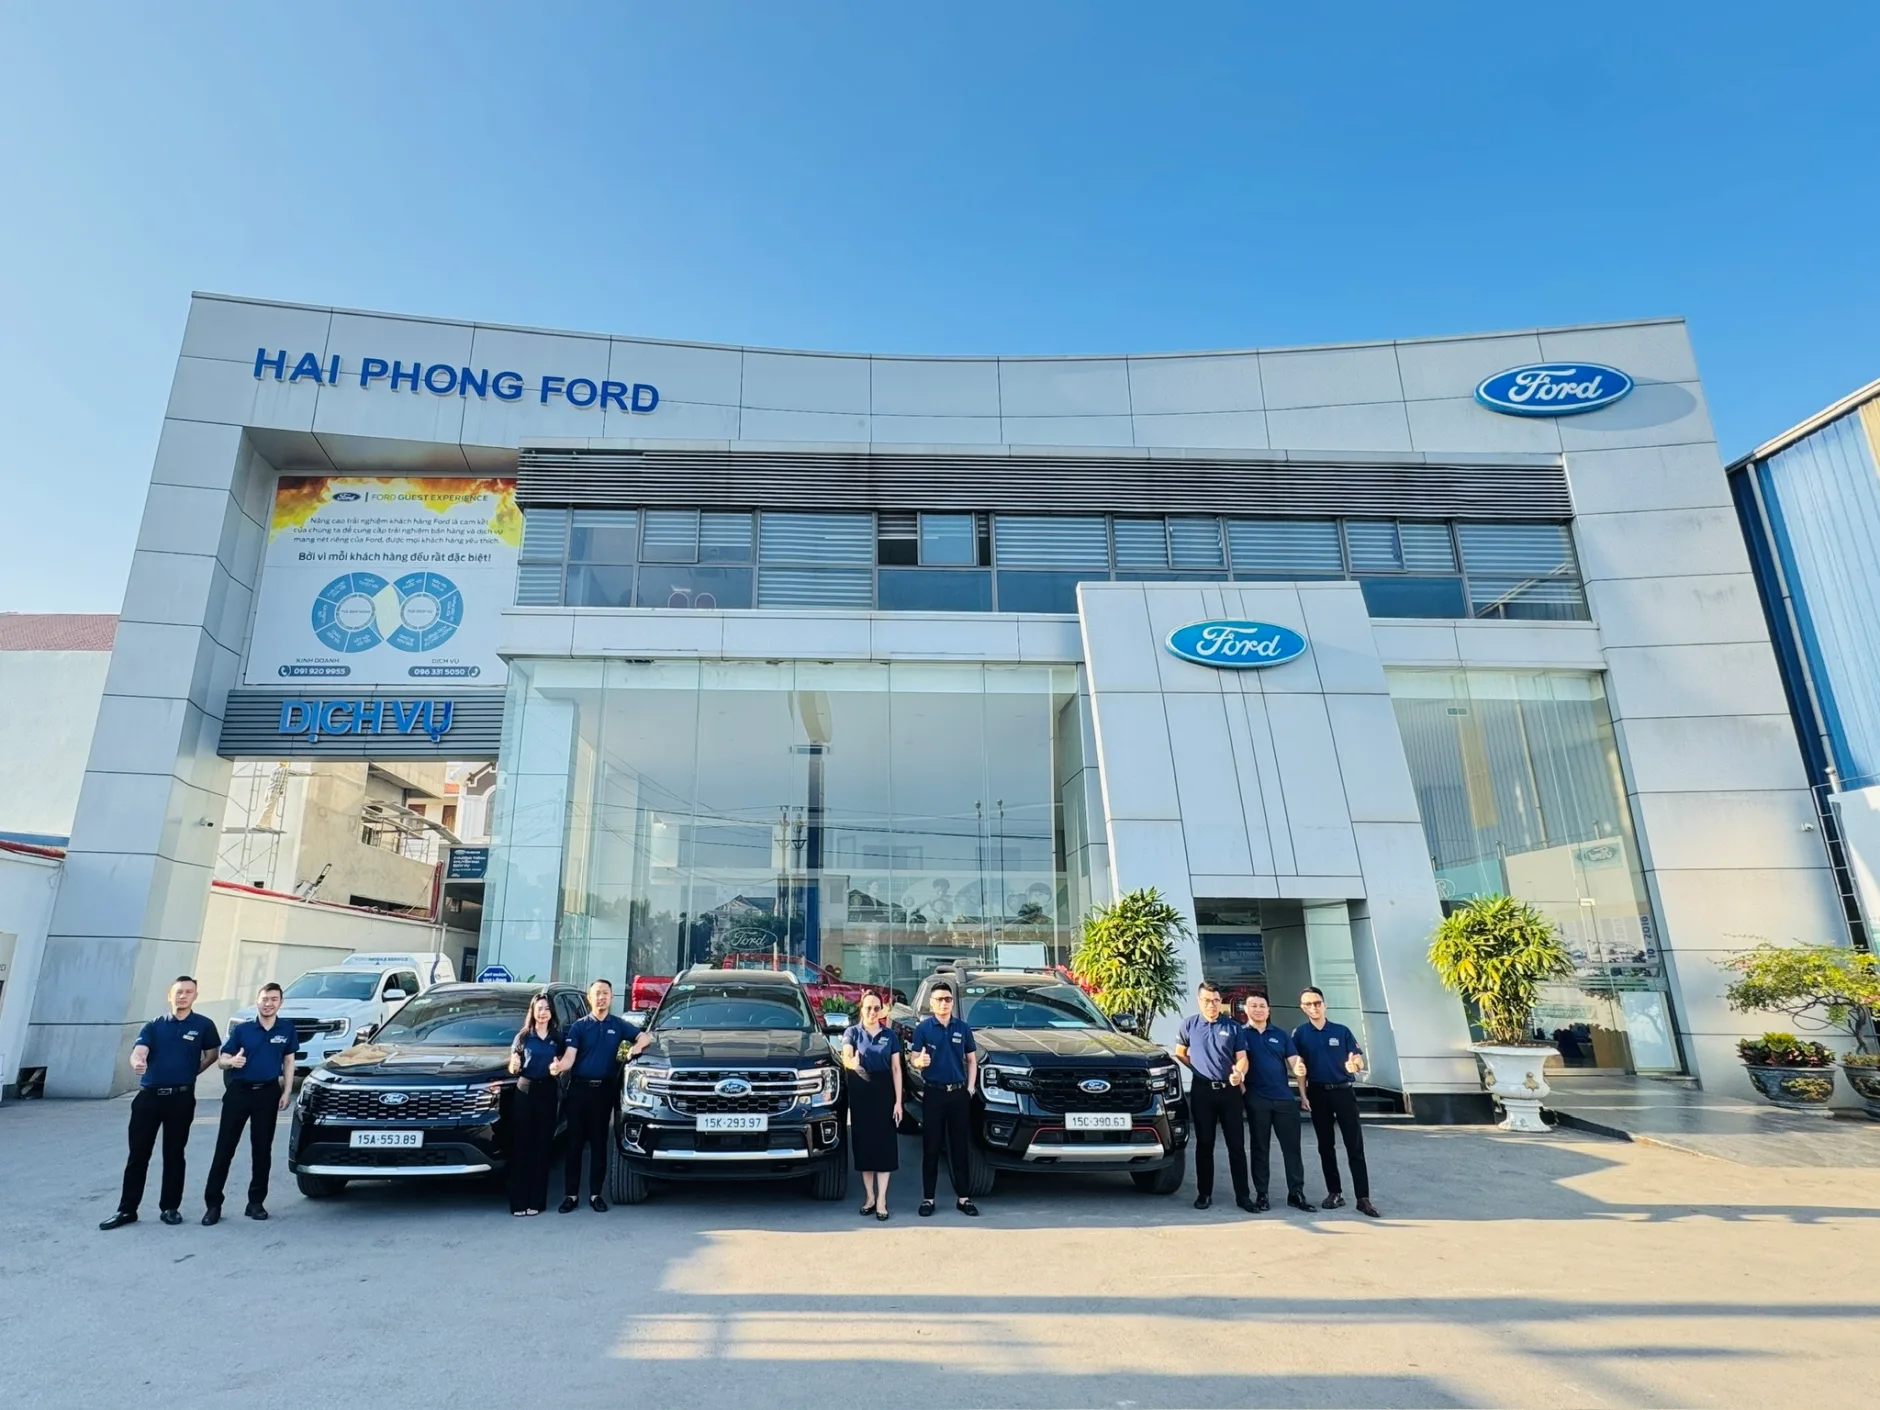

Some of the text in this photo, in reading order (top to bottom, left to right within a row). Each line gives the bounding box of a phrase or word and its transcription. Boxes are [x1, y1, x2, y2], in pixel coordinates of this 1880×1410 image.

[253, 347, 661, 415] HAI PHONG FORD
[1508, 369, 1603, 402] Ford
[371, 493, 396, 501] FORD
[397, 493, 429, 501] GUEST
[431, 494, 489, 502] EXPERIENCE
[360, 517, 388, 525] nghiệm
[330, 536, 350, 544] riêng
[298, 551, 315, 561] Bởi
[317, 551, 326, 561] vì
[328, 550, 347, 561] mỗi
[350, 551, 380, 561] khách
[382, 552, 408, 563] hàng
[410, 551, 429, 562] đều
[447, 552, 466, 563] đặc
[468, 552, 492, 563] biệt!
[1196, 626, 1282, 656] Ford
[293, 667, 346, 675] 091 920 9955
[444, 668, 465, 676] 5050
[278, 699, 454, 744] DỊCH VỤ
[730, 931, 767, 946] Ford
[1646, 948, 1656, 959] 10
[704, 1117, 762, 1128] 15K-293.97
[1072, 1117, 1126, 1127] 15C-390.63
[358, 1134, 417, 1145] 15A-553.89
